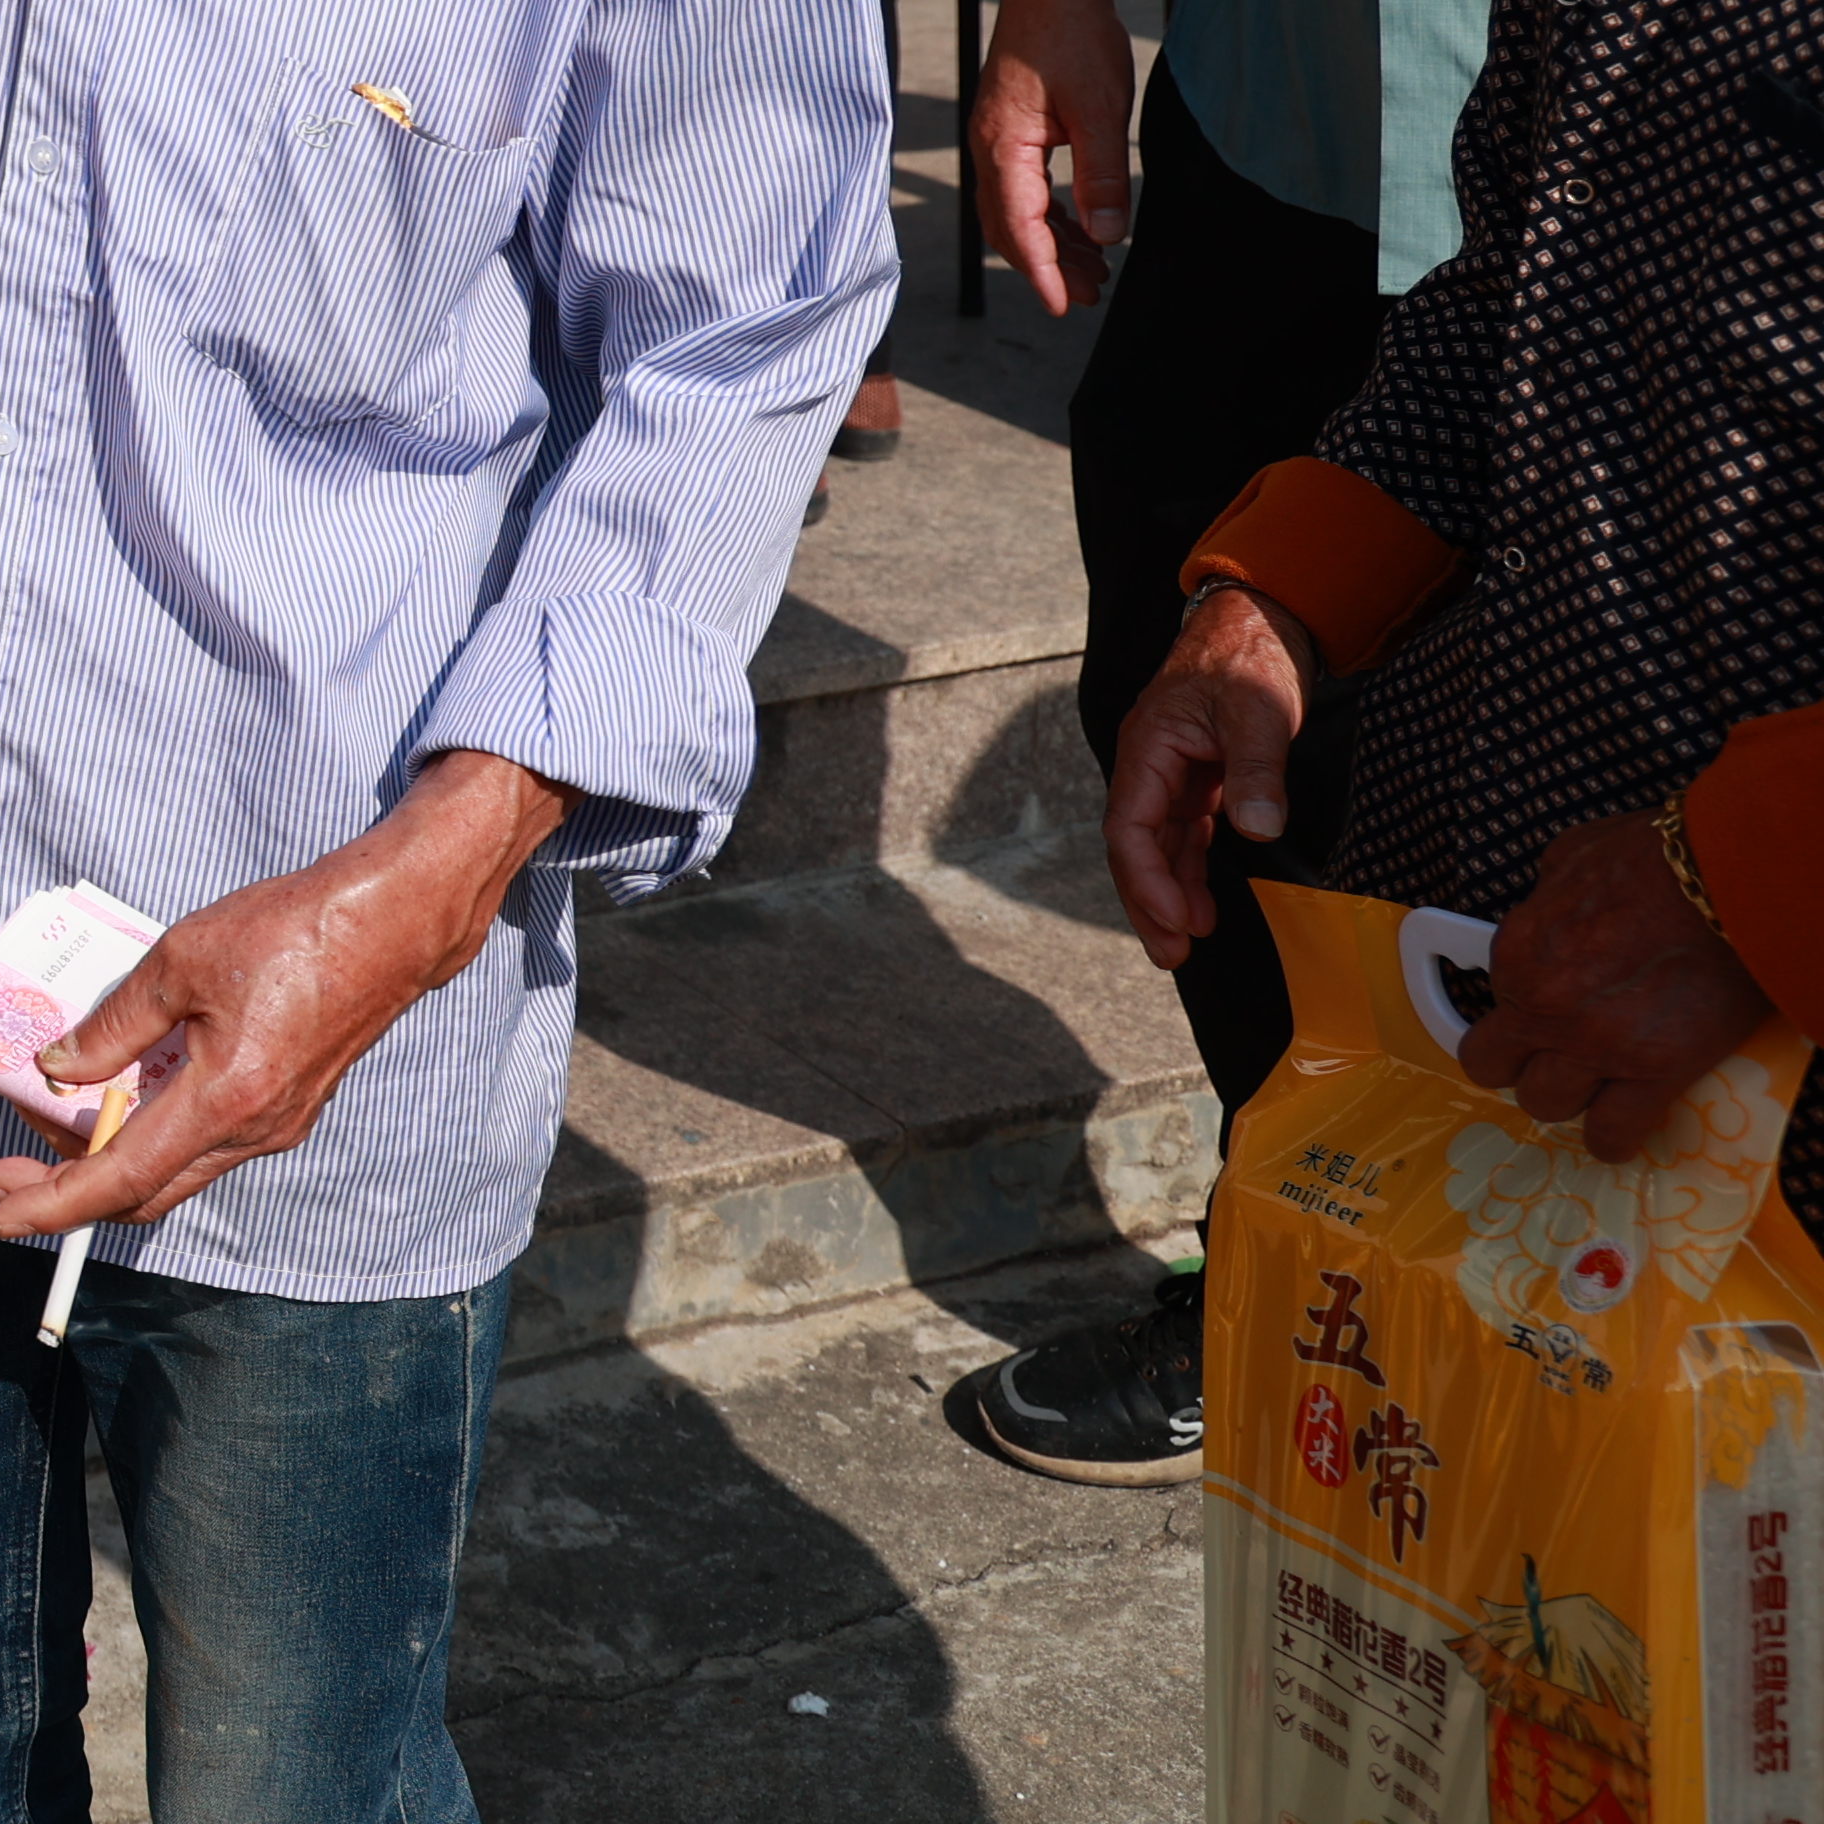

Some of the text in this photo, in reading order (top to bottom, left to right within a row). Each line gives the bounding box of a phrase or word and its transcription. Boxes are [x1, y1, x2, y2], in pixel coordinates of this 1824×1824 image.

[1277, 1180, 1364, 1227] mijieer
[1295, 1142, 1382, 1198] 米姐儿
[1305, 1385, 1342, 1483] 大米
[1276, 1567, 1448, 1709] 经典稻花香2号
